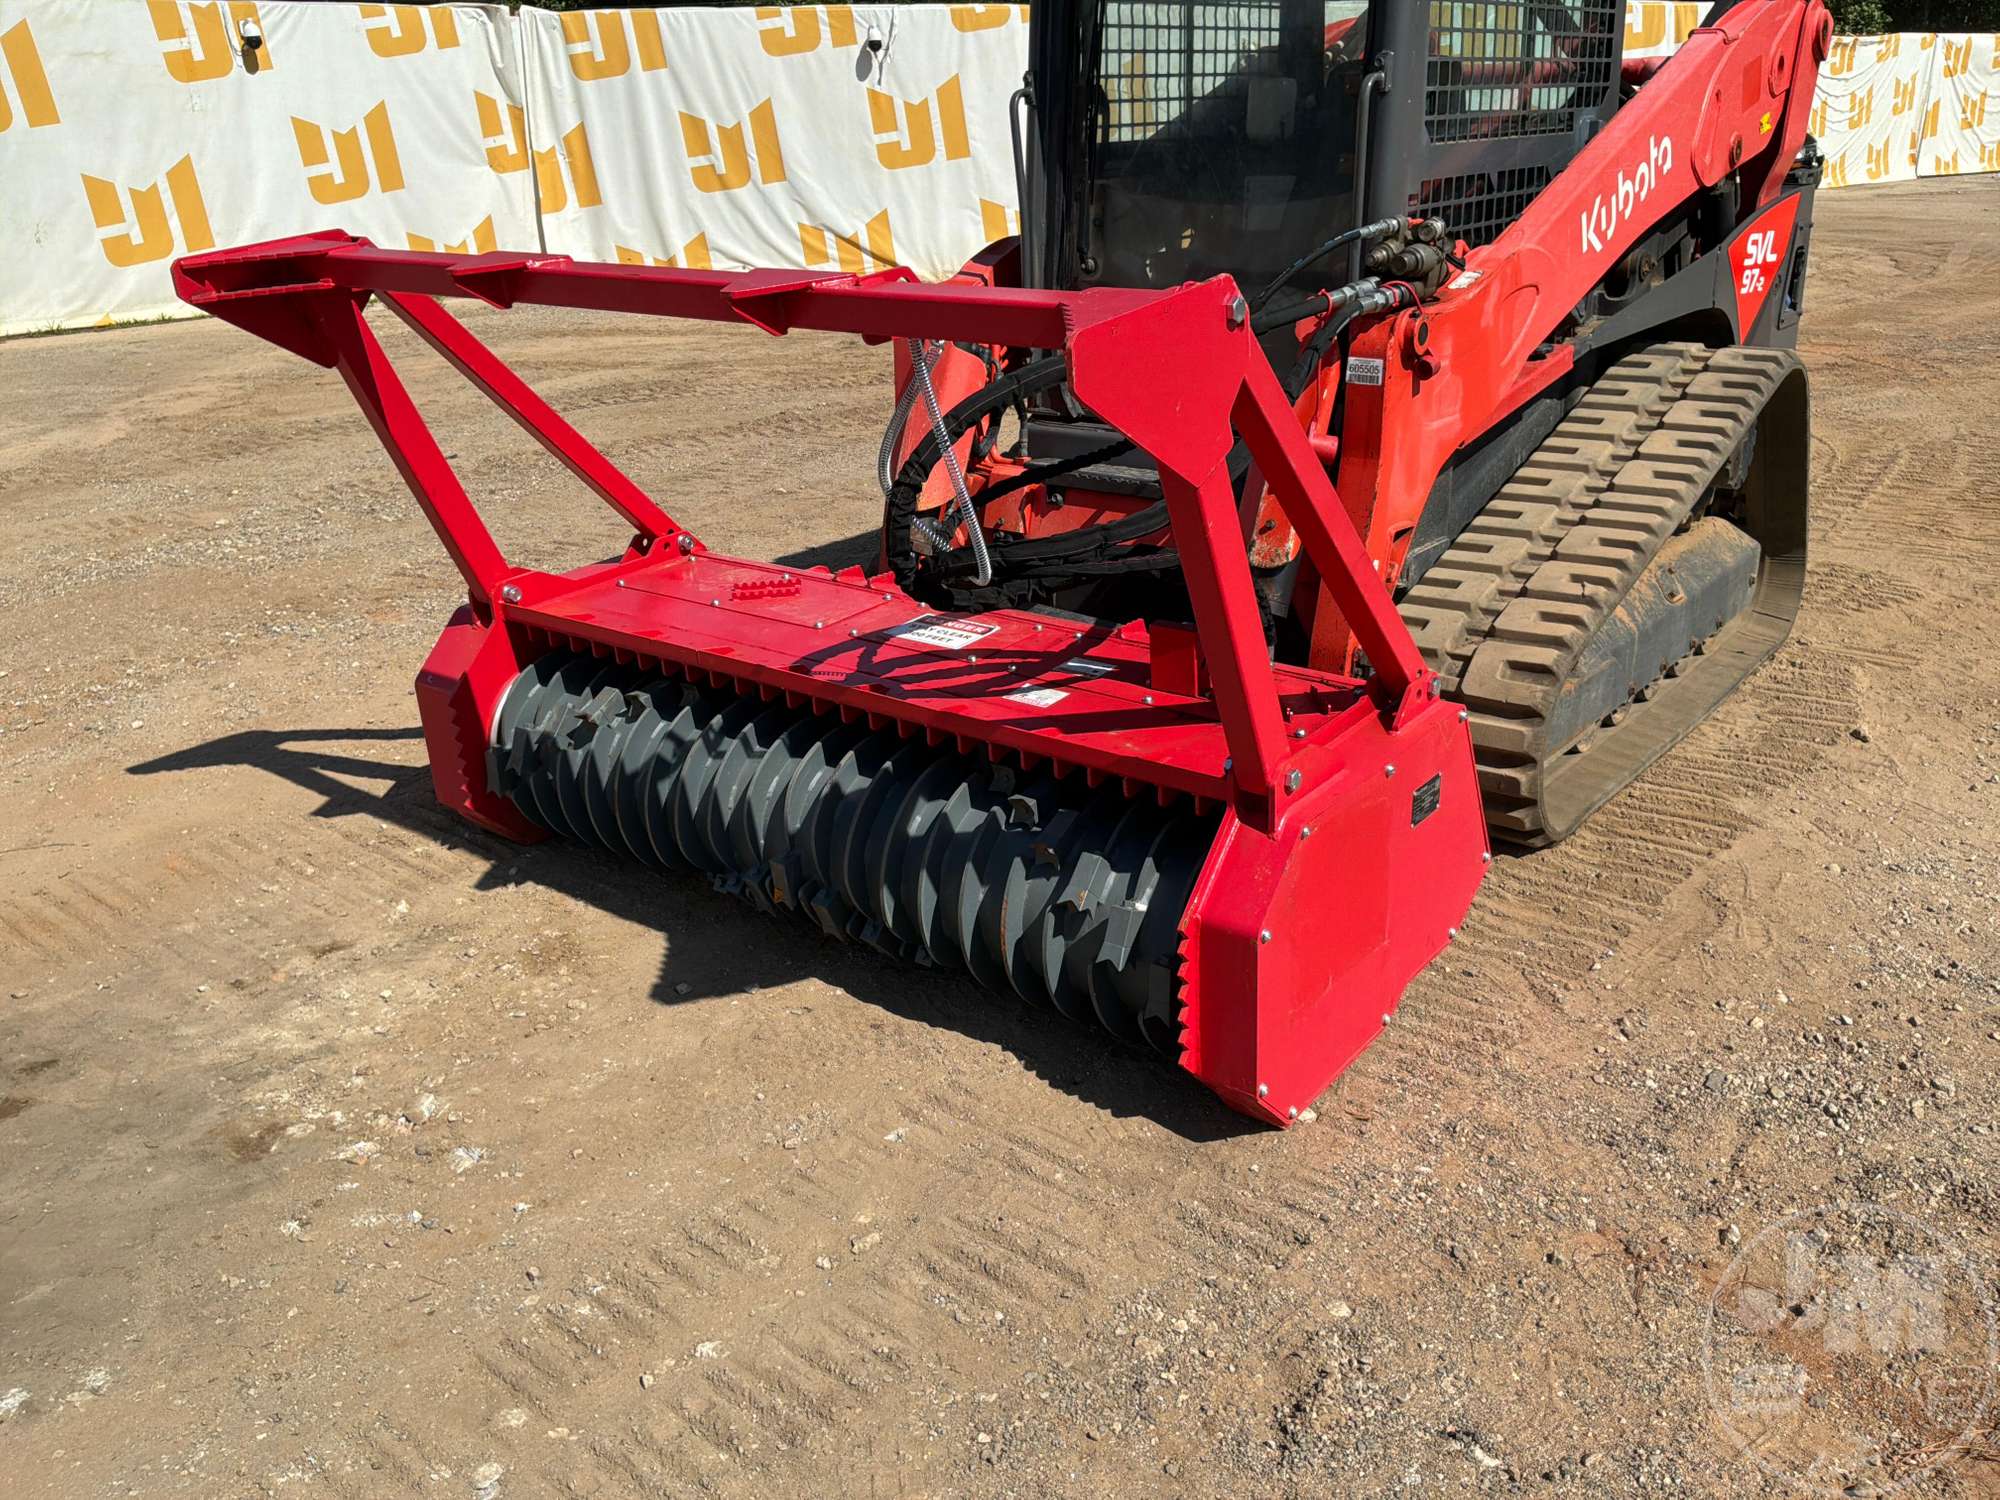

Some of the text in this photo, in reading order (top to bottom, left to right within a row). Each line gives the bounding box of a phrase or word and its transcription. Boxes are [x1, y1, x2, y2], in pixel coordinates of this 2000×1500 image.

[1581, 133, 1672, 255] Kubota
[1744, 230, 1777, 266] SVL
[1349, 363, 1380, 375] 605505
